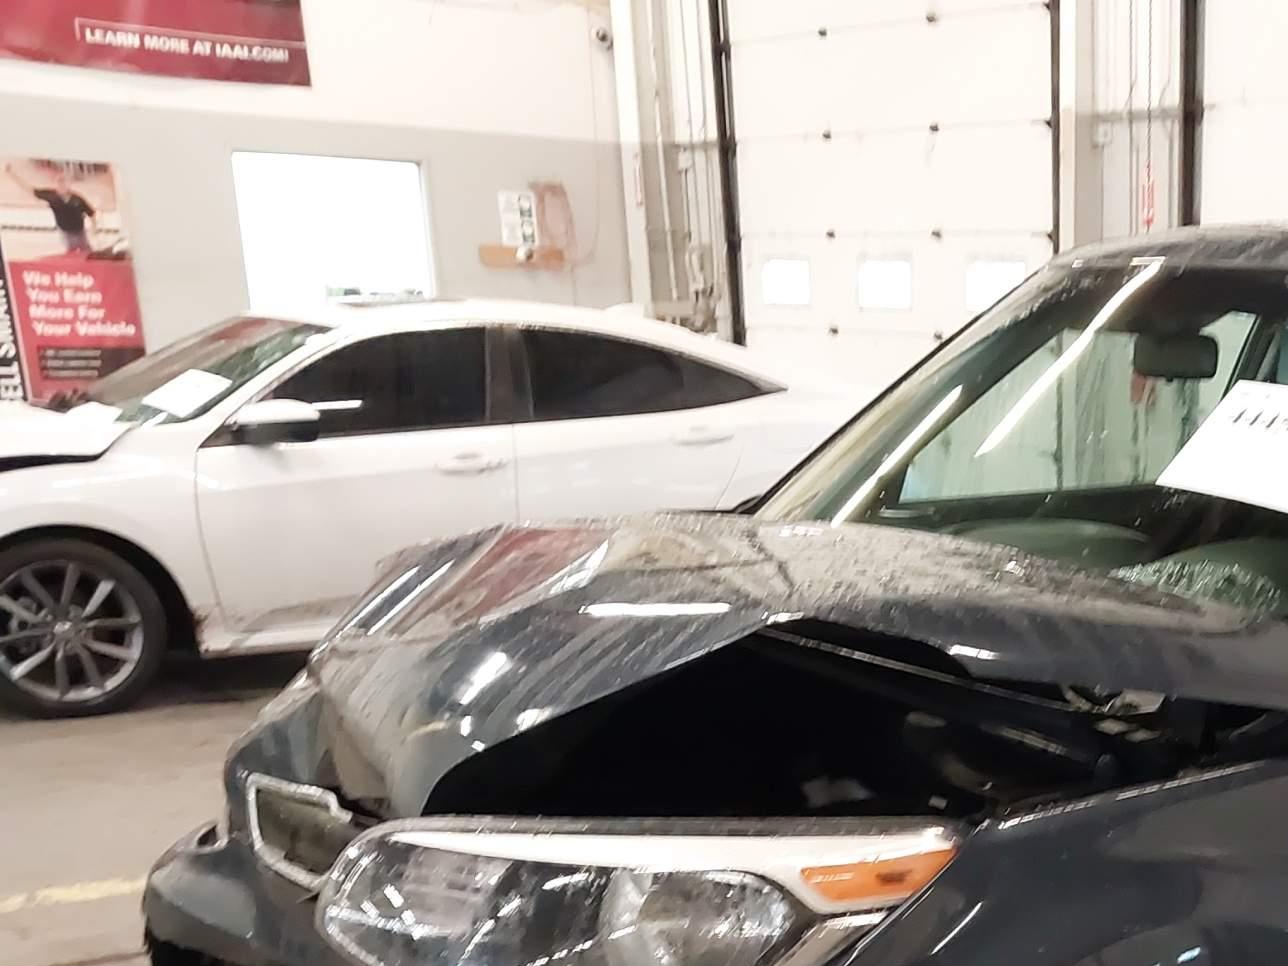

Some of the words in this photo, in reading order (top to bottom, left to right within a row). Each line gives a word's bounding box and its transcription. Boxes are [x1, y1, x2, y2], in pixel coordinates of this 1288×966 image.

[85, 27, 140, 49] LEARN
[144, 33, 190, 54] MORE
[193, 39, 213, 57] AT
[23, 270, 51, 287] We
[54, 271, 94, 290] Help
[26, 287, 60, 304] You
[63, 288, 102, 304] Earn
[29, 304, 74, 320] More
[78, 304, 105, 320] For
[32, 320, 72, 336] Your
[75, 320, 136, 337] Vehicle
